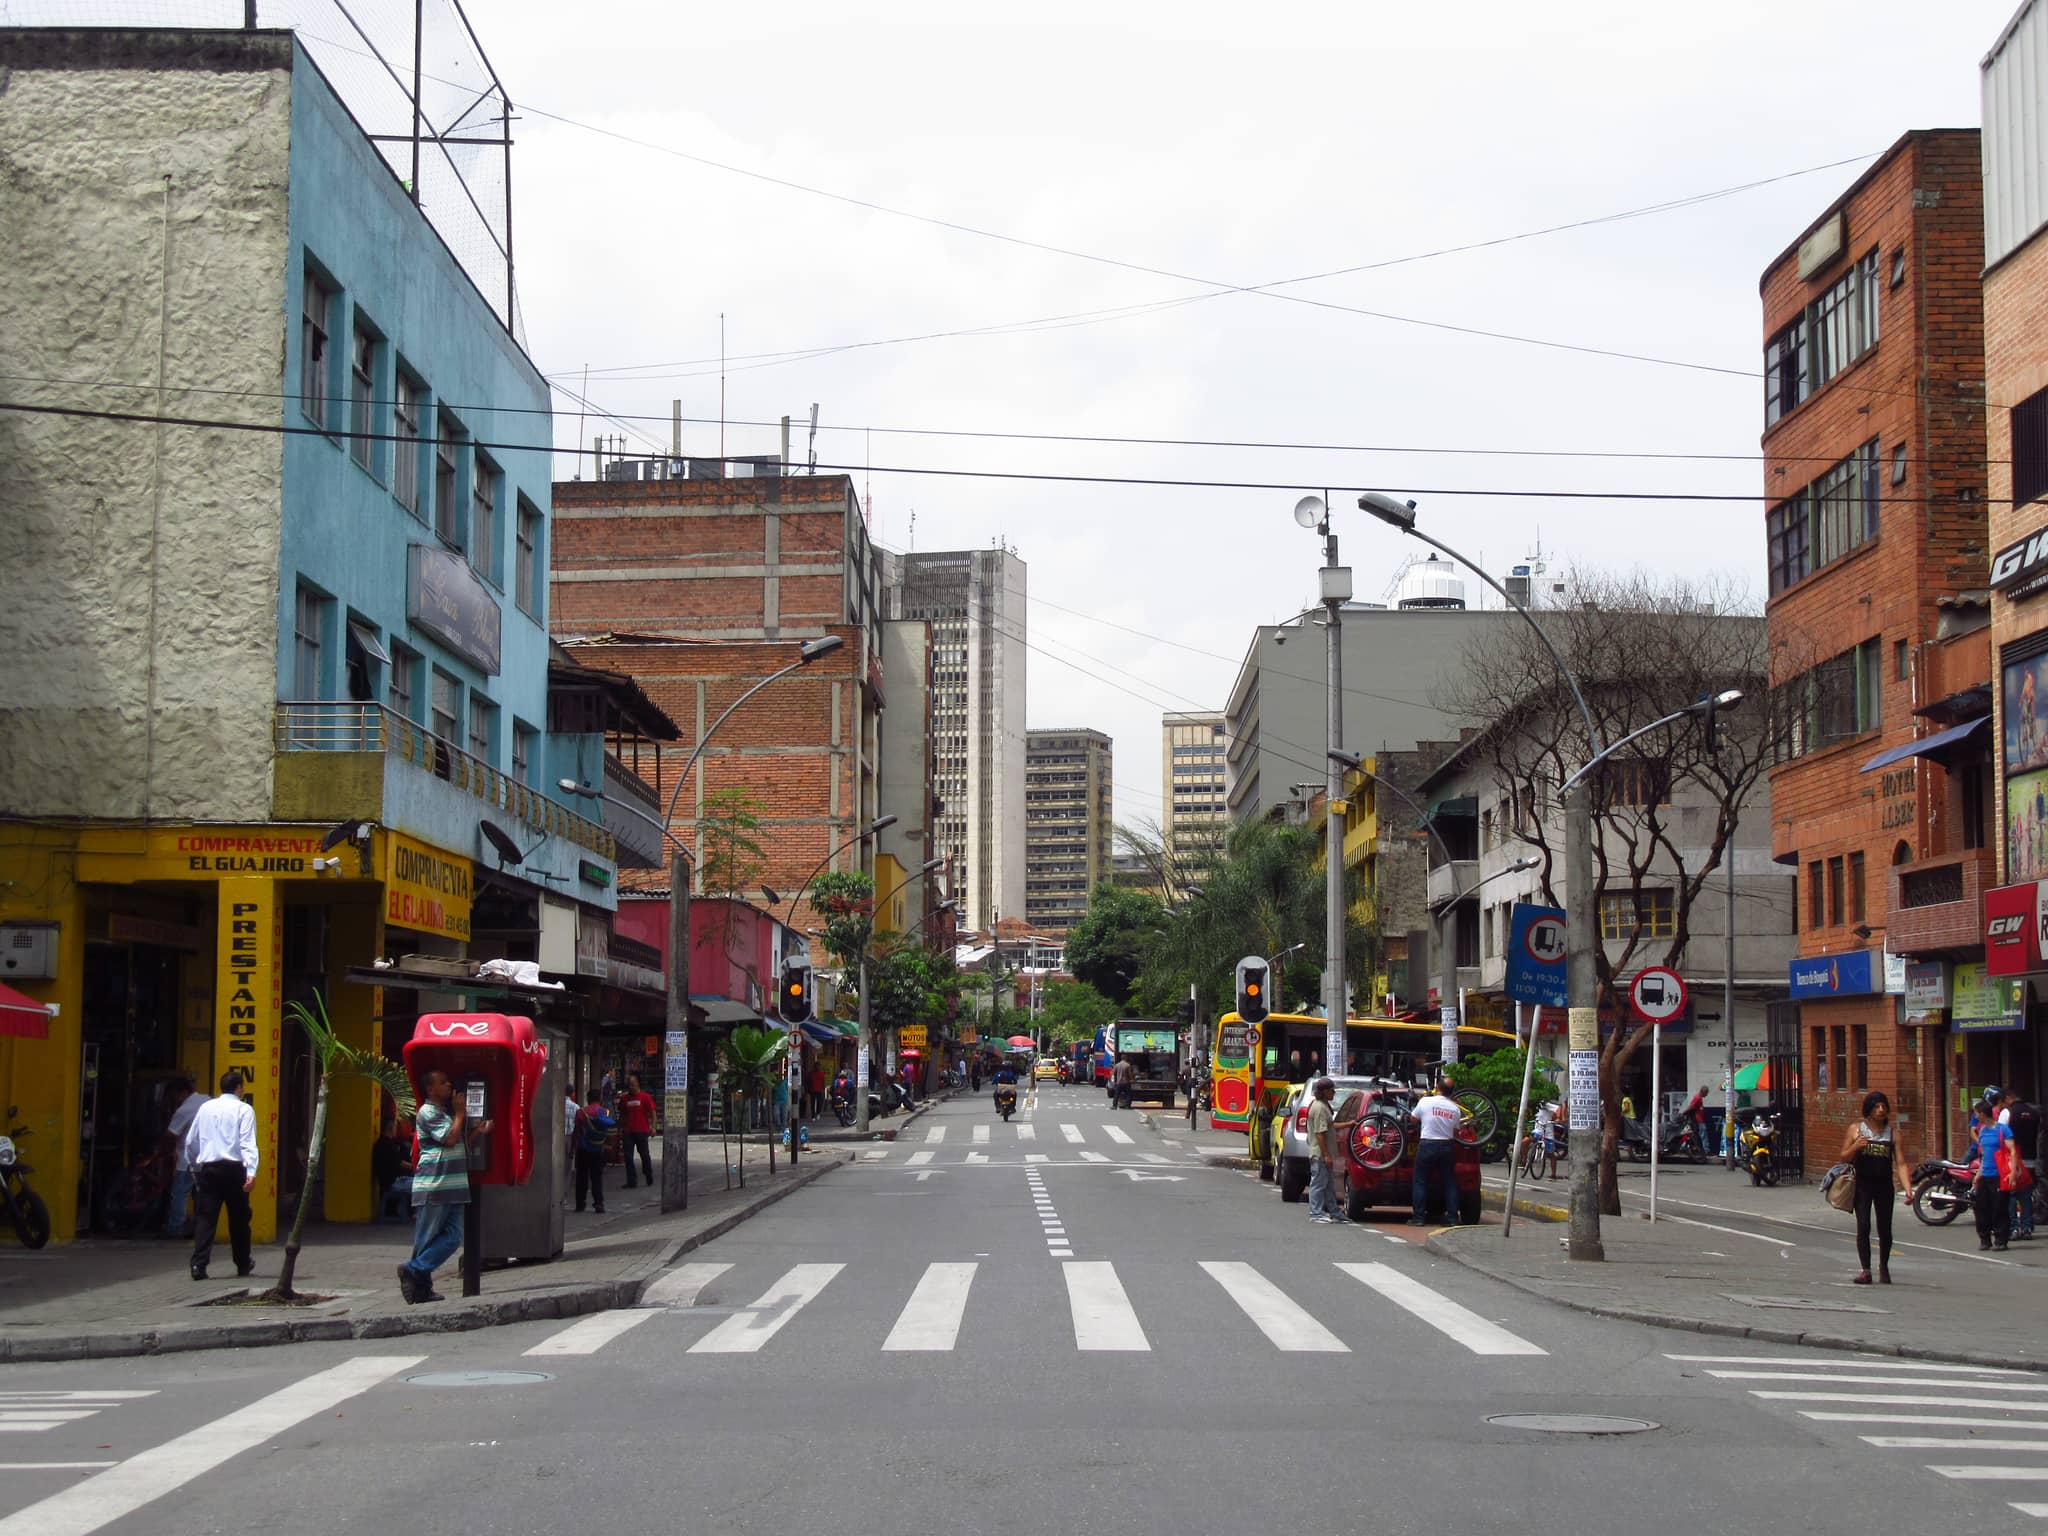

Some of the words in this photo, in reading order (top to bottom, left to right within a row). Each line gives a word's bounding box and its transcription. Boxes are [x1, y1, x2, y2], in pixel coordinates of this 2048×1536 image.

[1882, 768, 1915, 798] HOTEL
[190, 856, 212, 871] EL
[215, 857, 304, 872] GUAJIRO
[396, 845, 468, 899] COMPRAVENTA
[389, 889, 401, 920] EL
[404, 894, 445, 929] GUAJIRO
[1988, 914, 2025, 936] GW
[229, 903, 258, 1054] PRESTAMOS
[1796, 972, 1808, 987] Banco
[1814, 968, 1829, 987] Bogotá
[429, 1021, 489, 1036] une
[268, 1116, 278, 1198] PLATA
